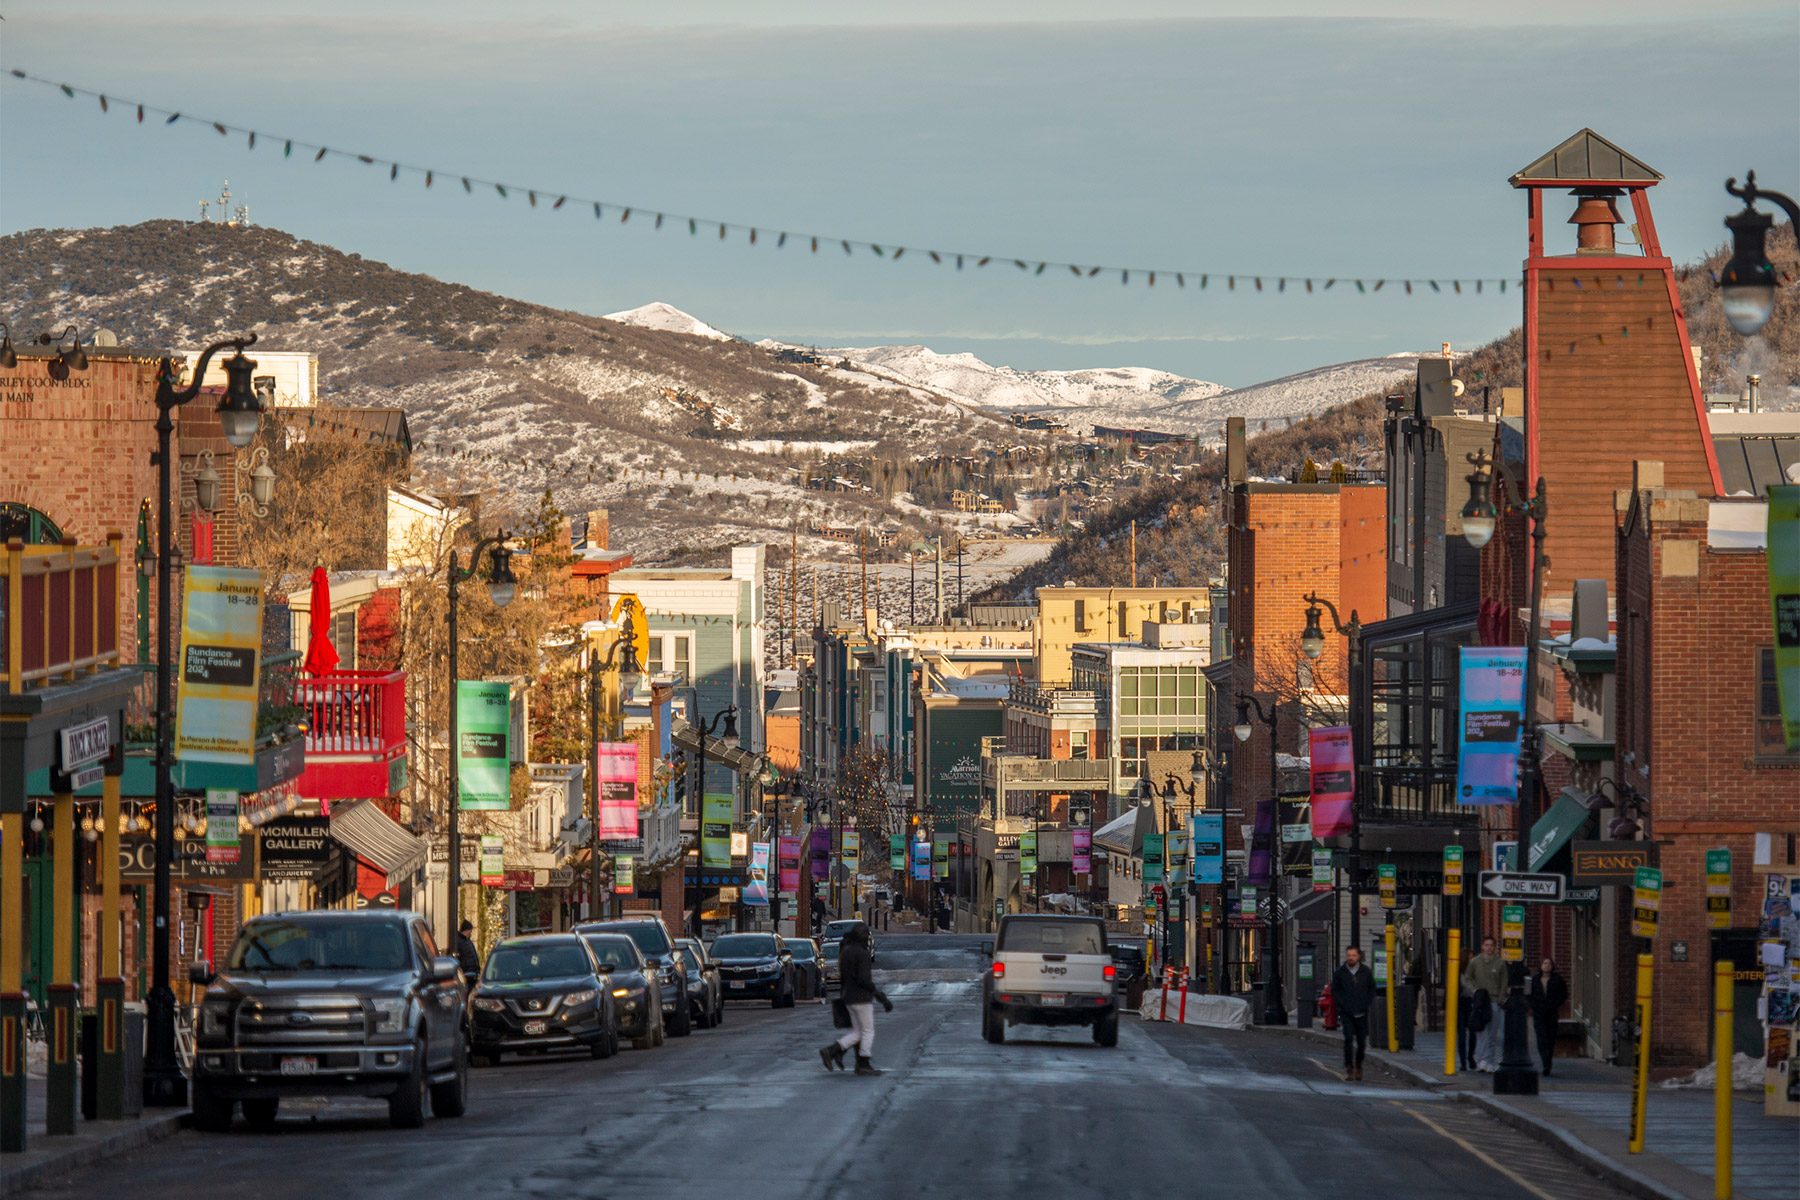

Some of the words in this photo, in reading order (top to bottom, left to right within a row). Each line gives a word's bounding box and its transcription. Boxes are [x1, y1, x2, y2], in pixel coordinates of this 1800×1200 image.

[7, 392, 34, 402] MAIN
[216, 582, 259, 595] January
[188, 647, 232, 658] Sundance
[187, 656, 206, 666] Film
[207, 657, 241, 668] Festival
[1488, 660, 1523, 668] January
[187, 664, 209, 679] 2024
[260, 827, 329, 837] MCMILLEN
[266, 839, 324, 849] GALLERY
[1504, 881, 1527, 892] ONE
[1530, 882, 1553, 893] WAY
[1041, 965, 1067, 976] Jeep
